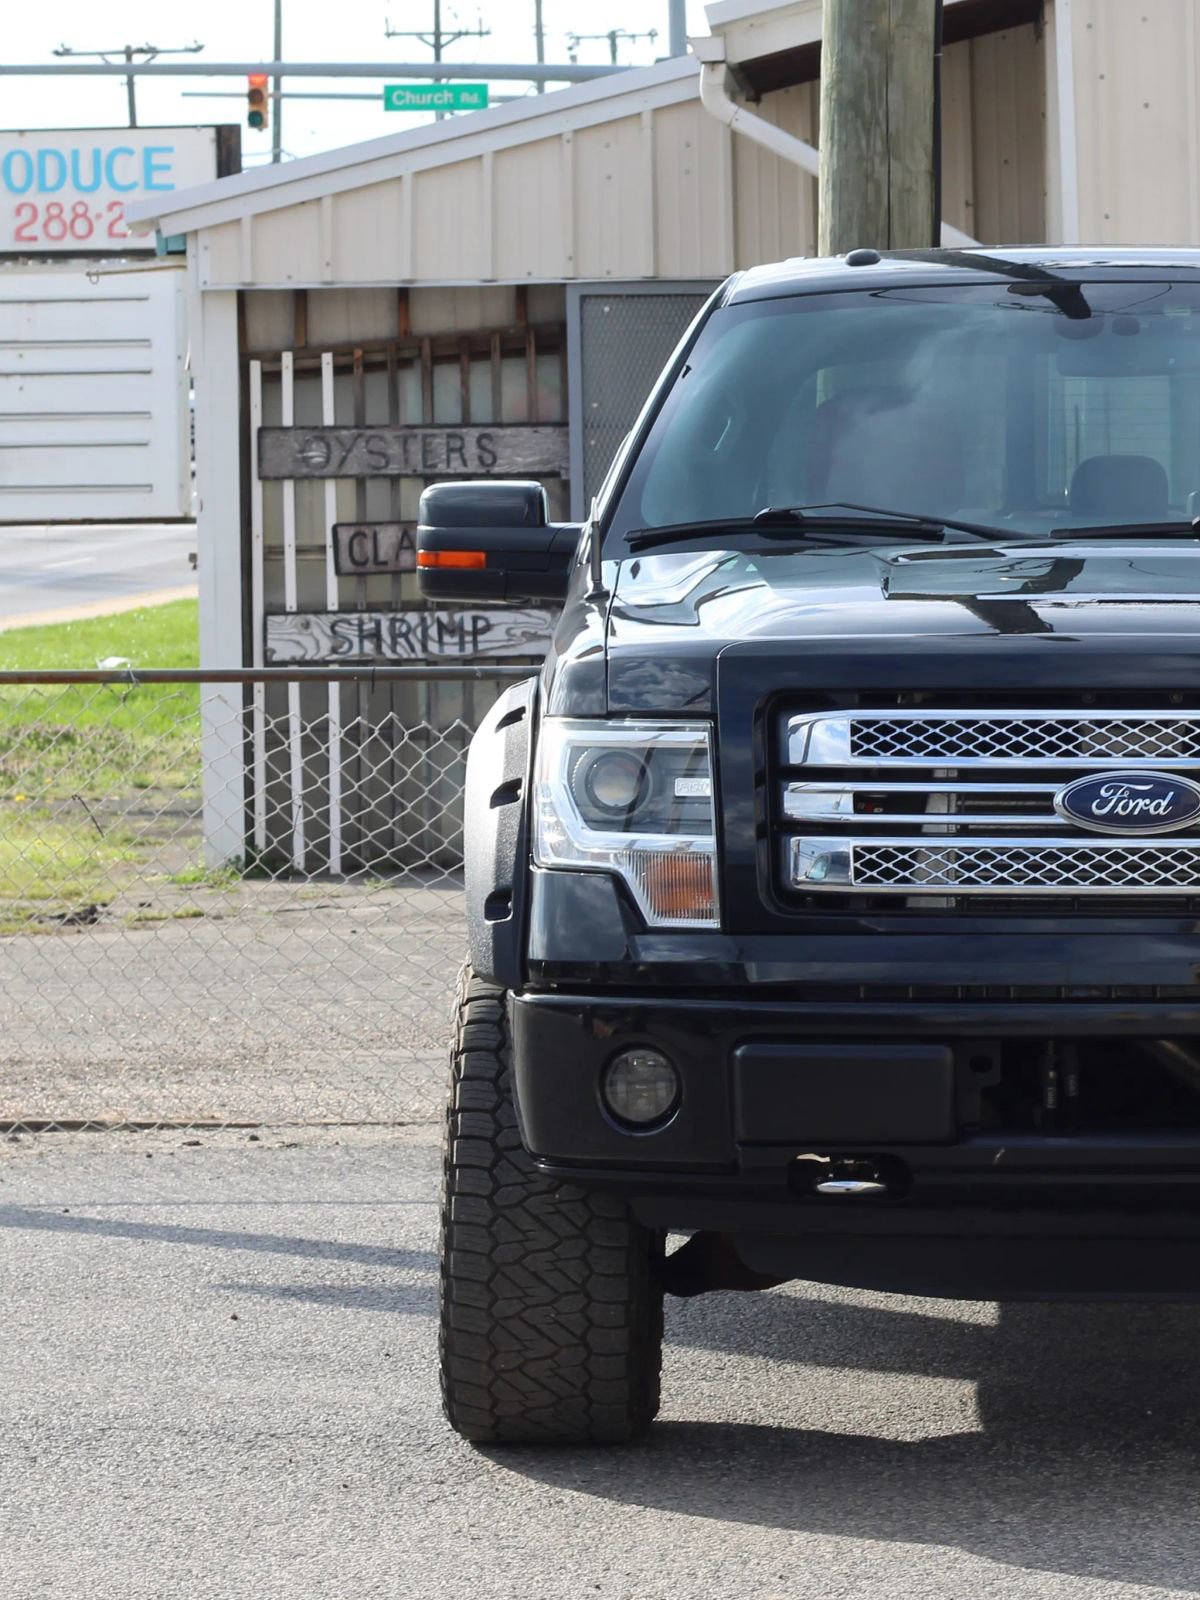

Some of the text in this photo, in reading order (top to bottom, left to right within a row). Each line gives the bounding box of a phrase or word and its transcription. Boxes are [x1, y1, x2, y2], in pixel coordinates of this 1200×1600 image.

[392, 90, 454, 105] Church
[2, 146, 176, 194] ODUCE
[302, 432, 498, 471] OYSTERS
[348, 527, 417, 567] CLA
[330, 614, 492, 656] SHRIMP
[1091, 782, 1175, 816] Ford
